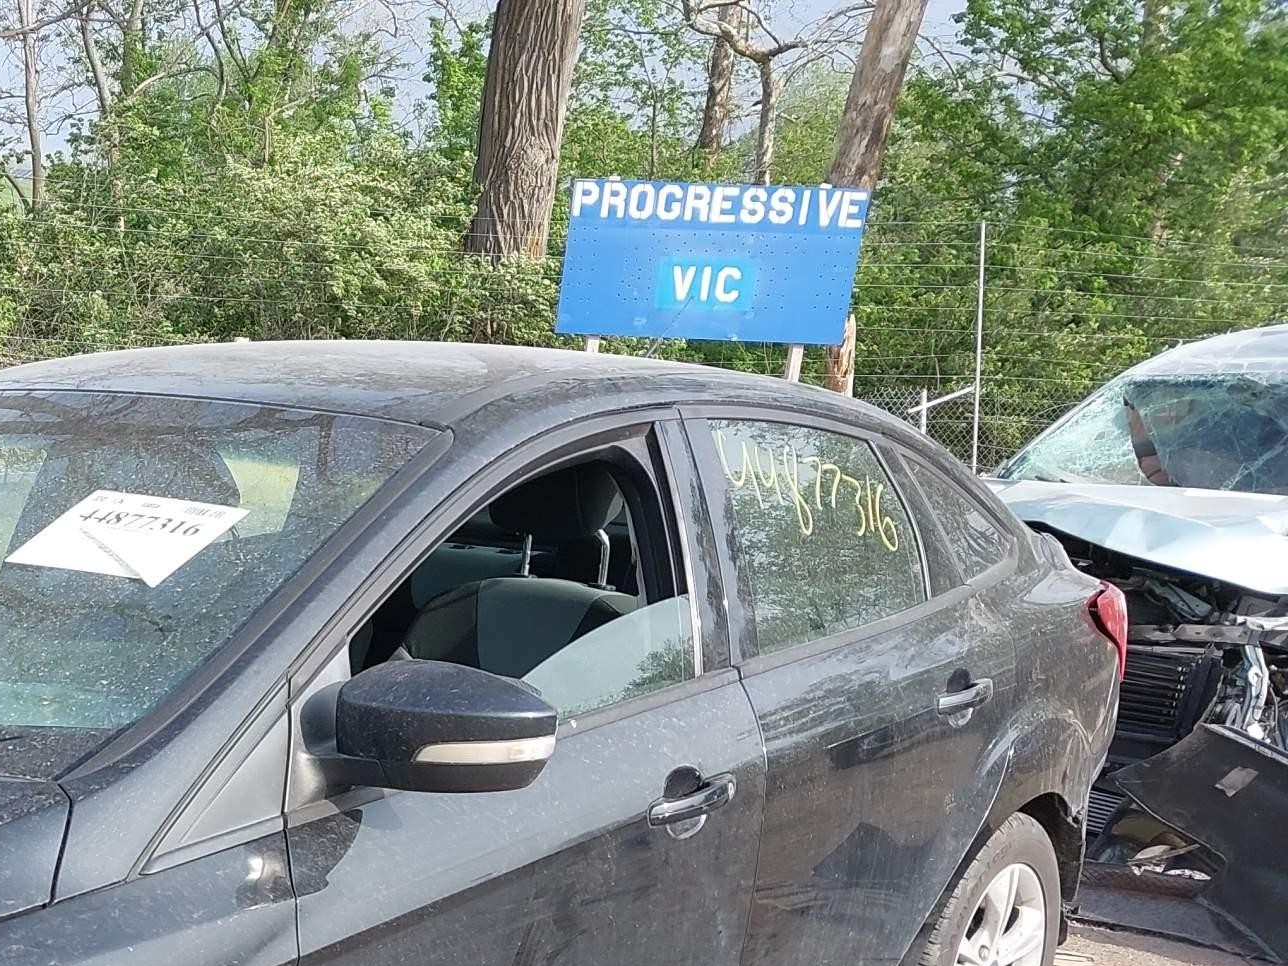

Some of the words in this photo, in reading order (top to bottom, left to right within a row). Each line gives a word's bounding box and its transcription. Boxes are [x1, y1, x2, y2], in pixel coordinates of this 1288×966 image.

[571, 181, 870, 228] PROGRESSIVE
[671, 265, 743, 303] VIC
[79, 508, 202, 537] 44877316
